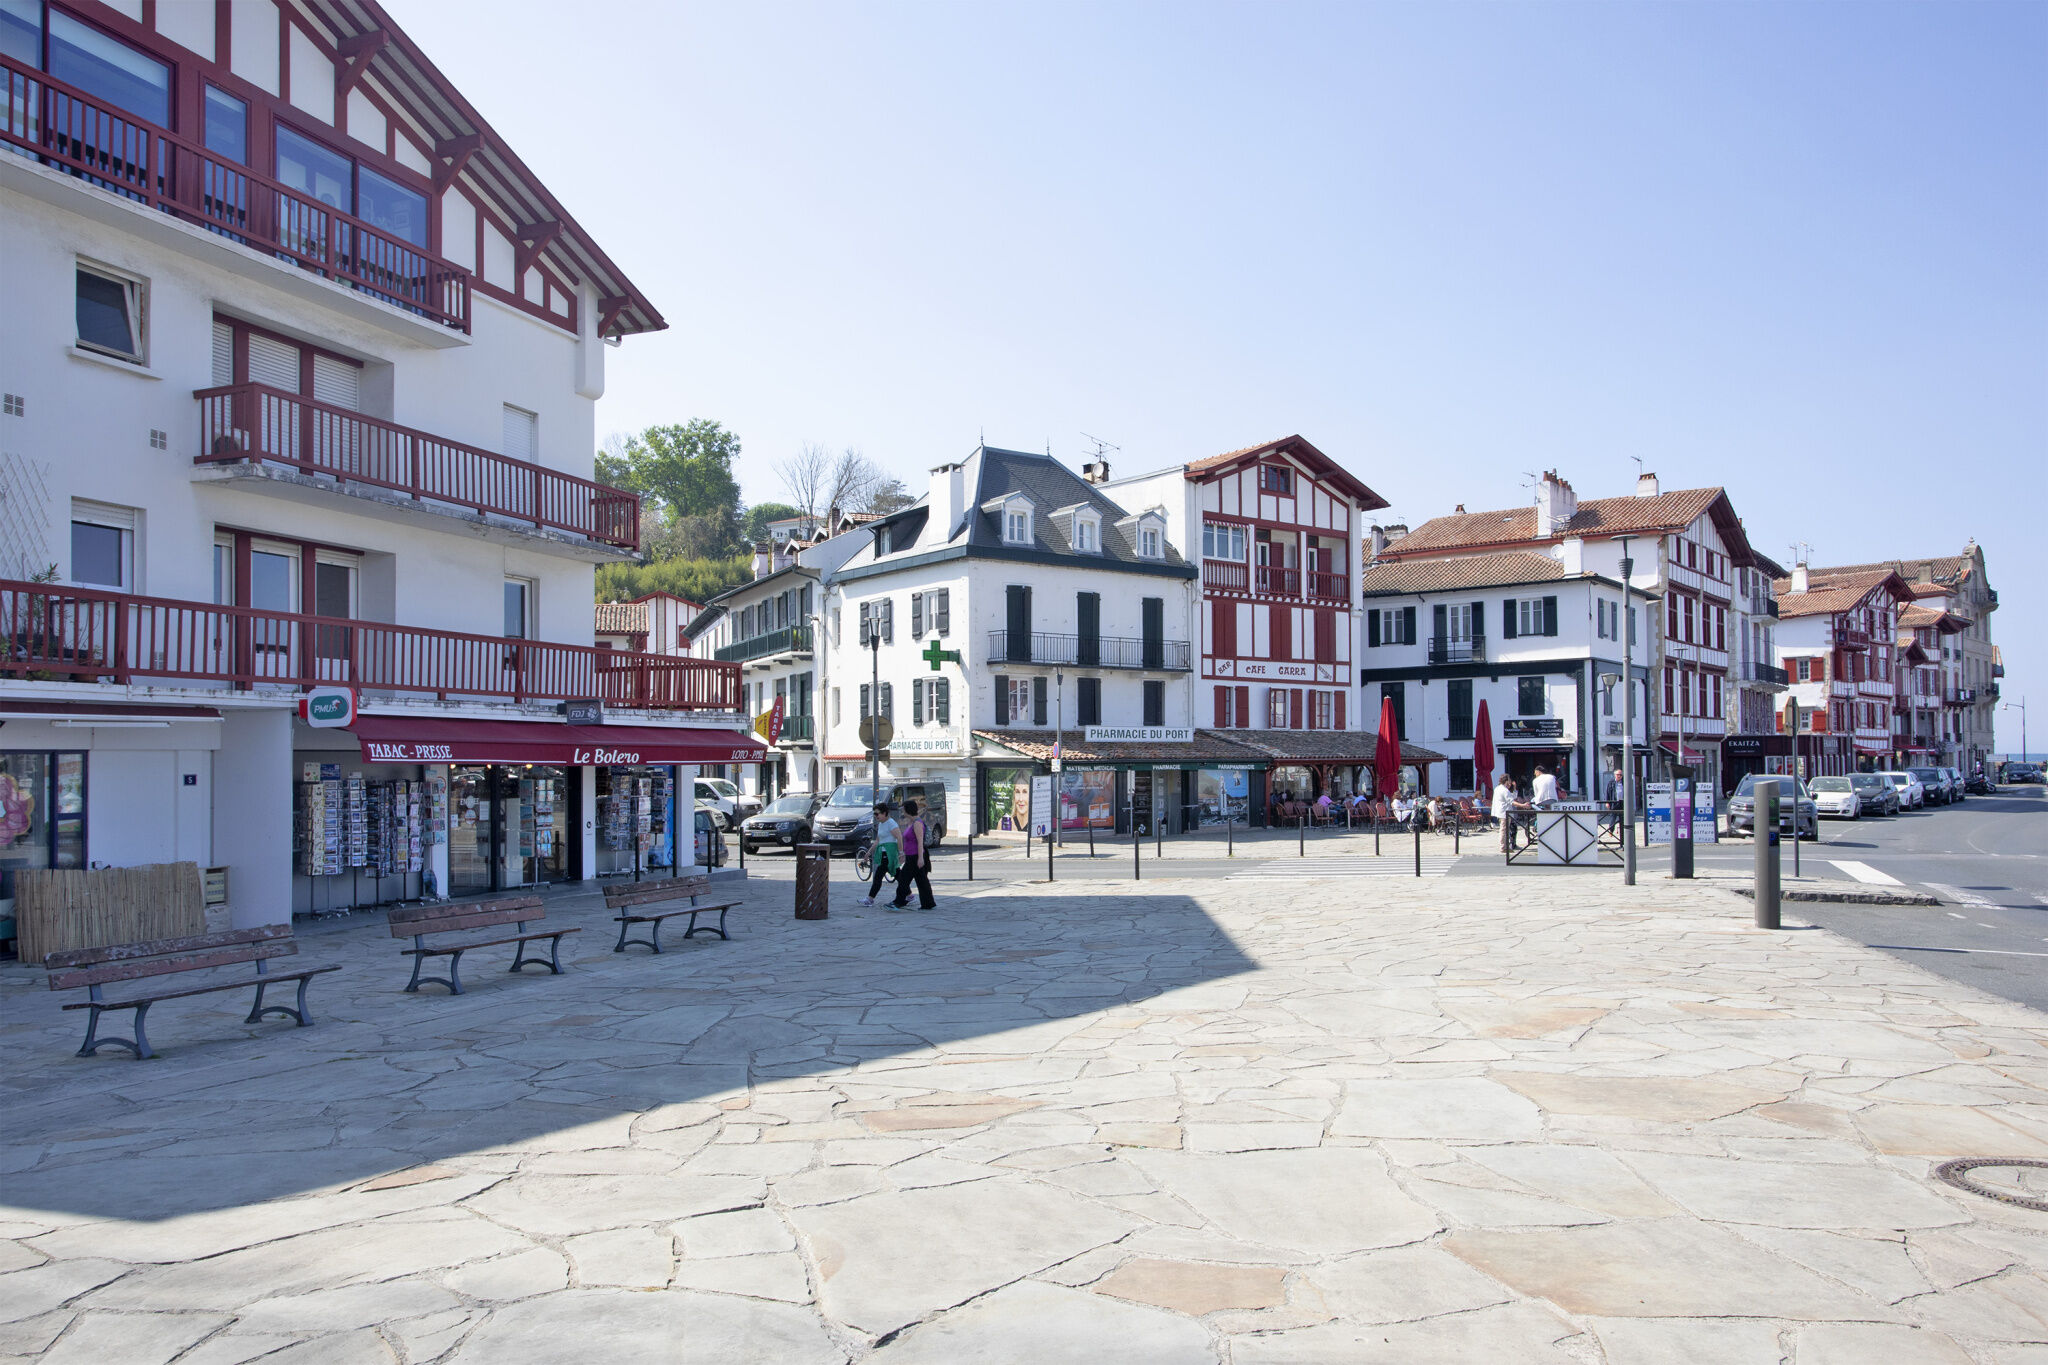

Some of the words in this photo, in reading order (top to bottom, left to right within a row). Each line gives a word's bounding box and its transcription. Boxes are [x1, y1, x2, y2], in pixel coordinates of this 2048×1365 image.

[1217, 660, 1232, 674] BAR
[1245, 665, 1266, 674] CAFE
[1278, 666, 1306, 676] GARRA
[313, 703, 332, 714] PMU
[570, 710, 585, 719] FDJ
[771, 705, 781, 736] TABAC
[1090, 729, 1147, 739] PHARMACIE
[1150, 729, 1162, 739] DU
[1165, 729, 1189, 739] PORT
[889, 740, 922, 750] HARMACIE
[924, 741, 933, 750] DU
[935, 740, 954, 750] PORT
[367, 743, 409, 758] TABAC
[416, 744, 453, 760] PRESSE
[573, 748, 590, 764] Le
[594, 748, 640, 764] Bolero
[731, 750, 749, 760] LOTO
